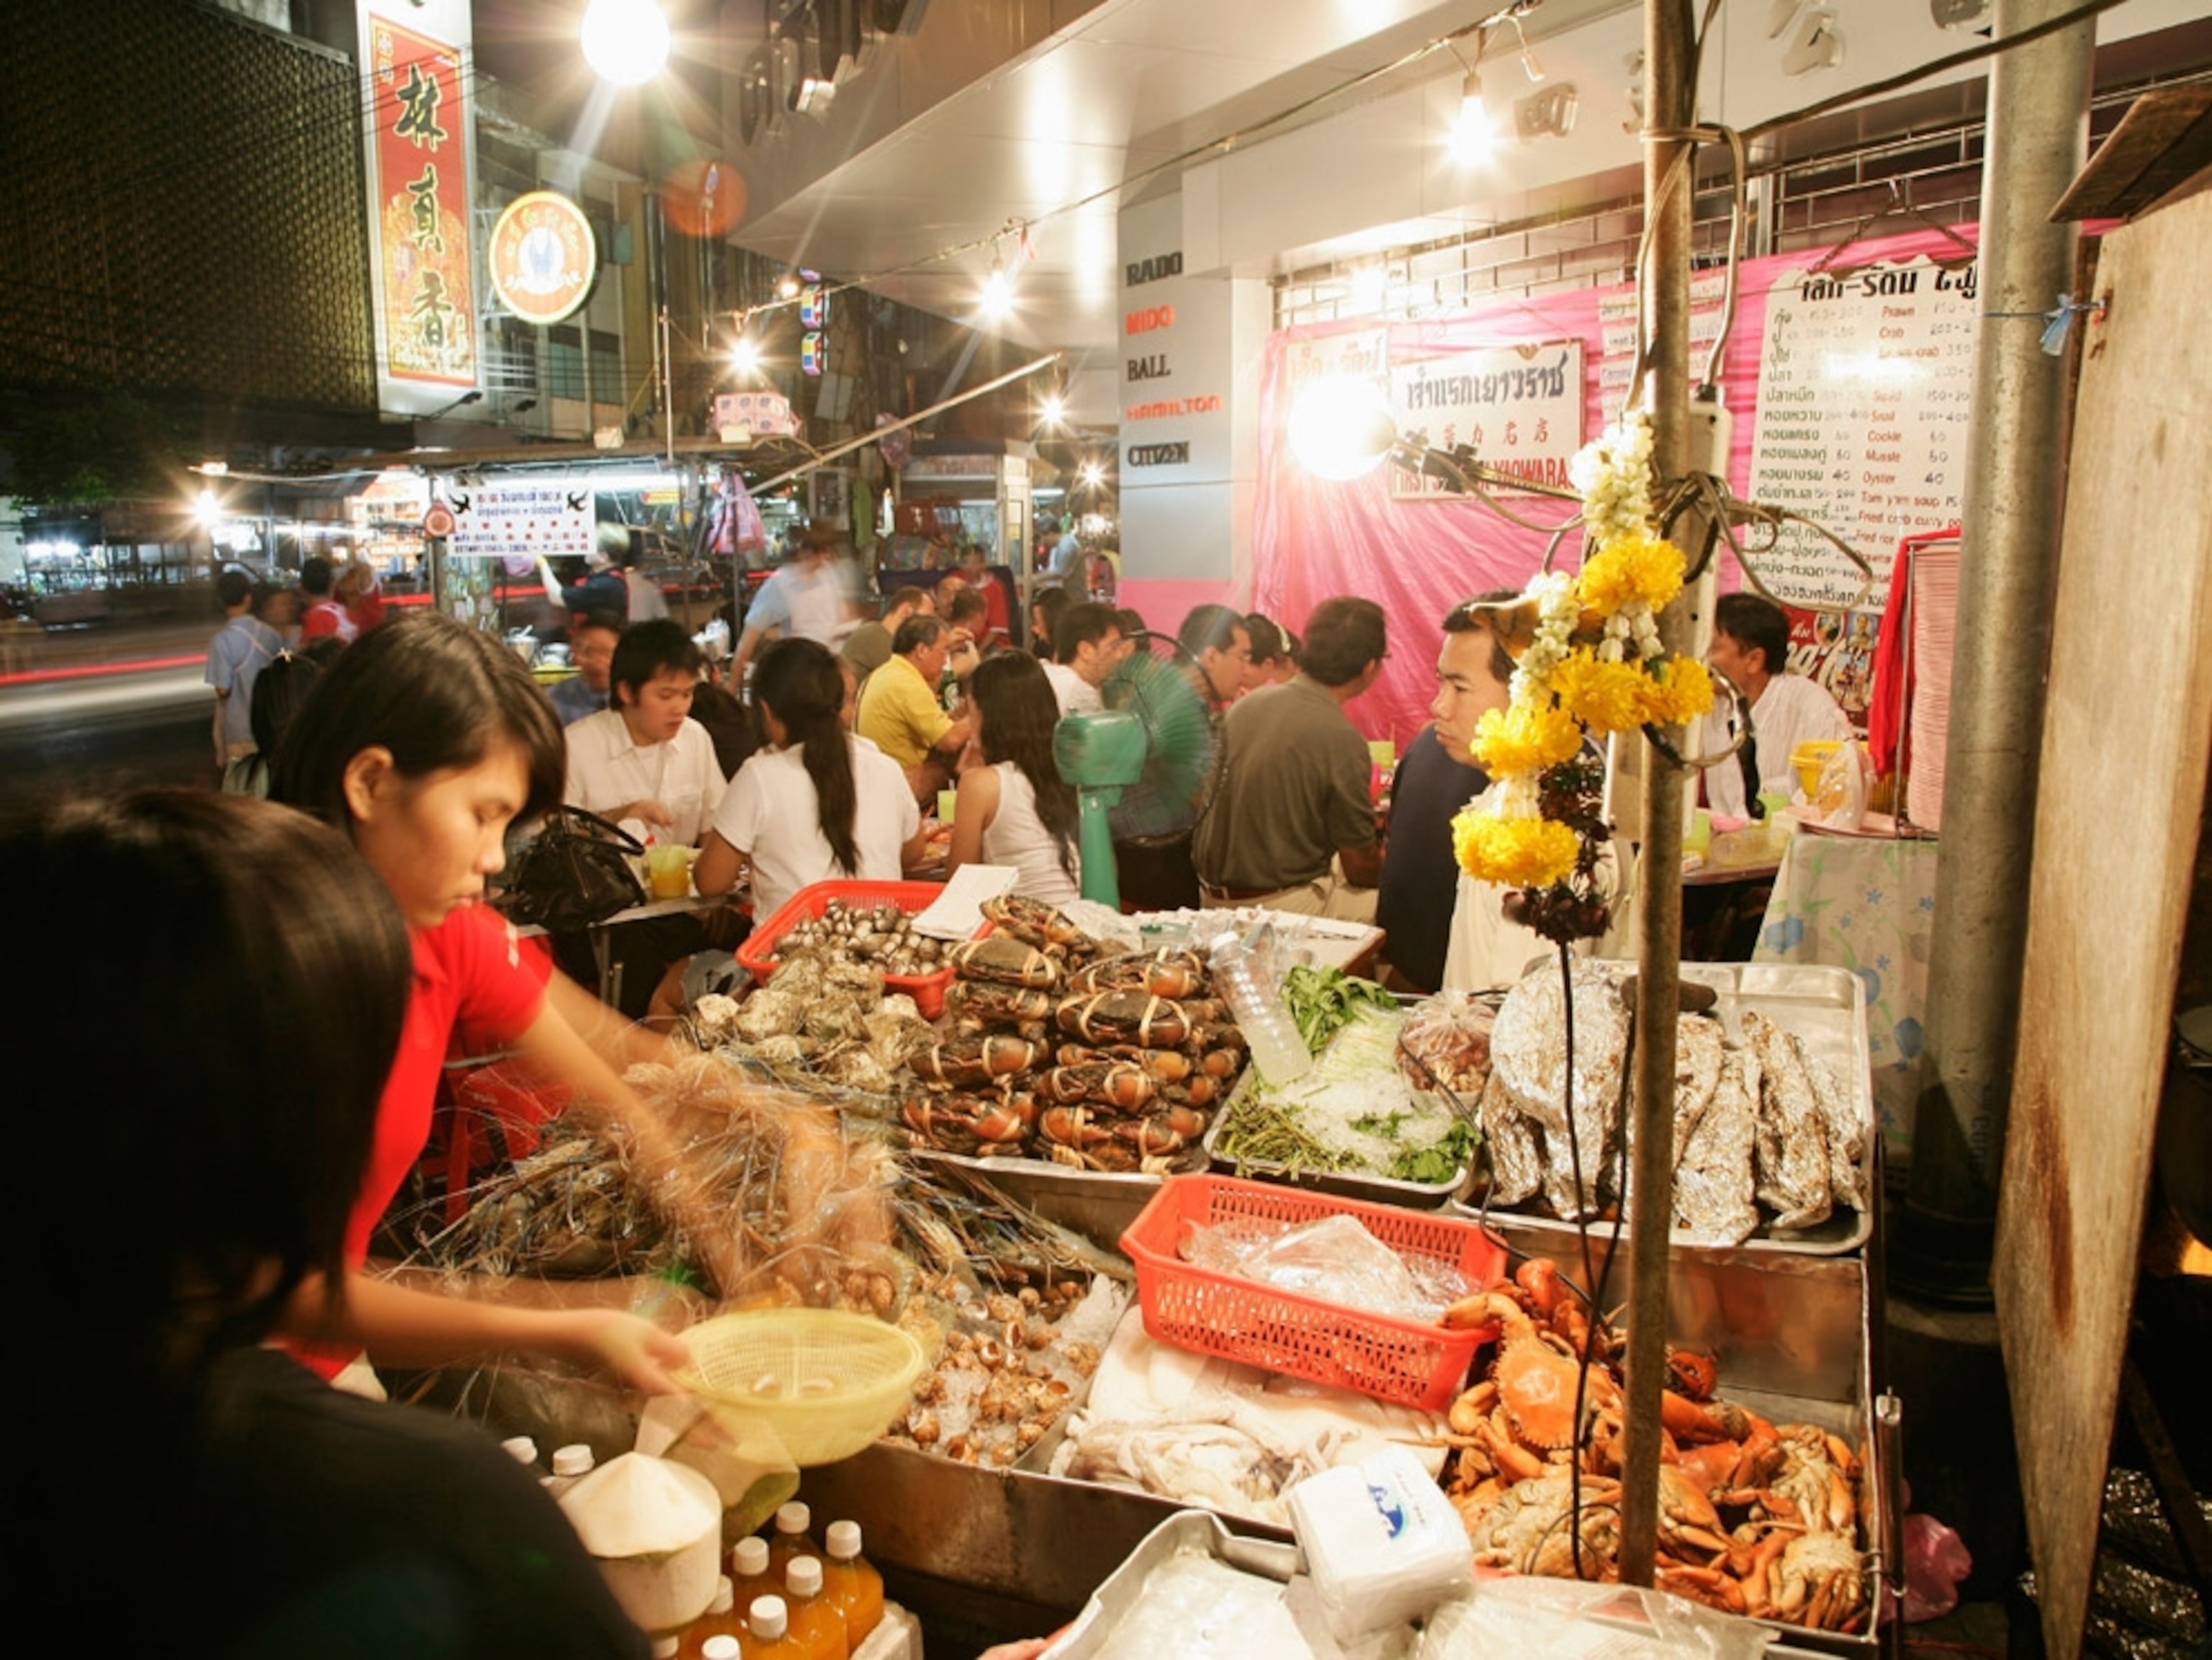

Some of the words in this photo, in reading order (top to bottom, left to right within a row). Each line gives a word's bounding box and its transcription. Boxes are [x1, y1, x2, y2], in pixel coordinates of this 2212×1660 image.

[392, 61, 453, 349] 林真香
[1125, 251, 1183, 287] RADO
[1125, 303, 1175, 336] MIDO
[1127, 354, 1172, 382] BALL
[1128, 441, 1191, 467] CITIZEN
[1924, 471, 1945, 485] 40
